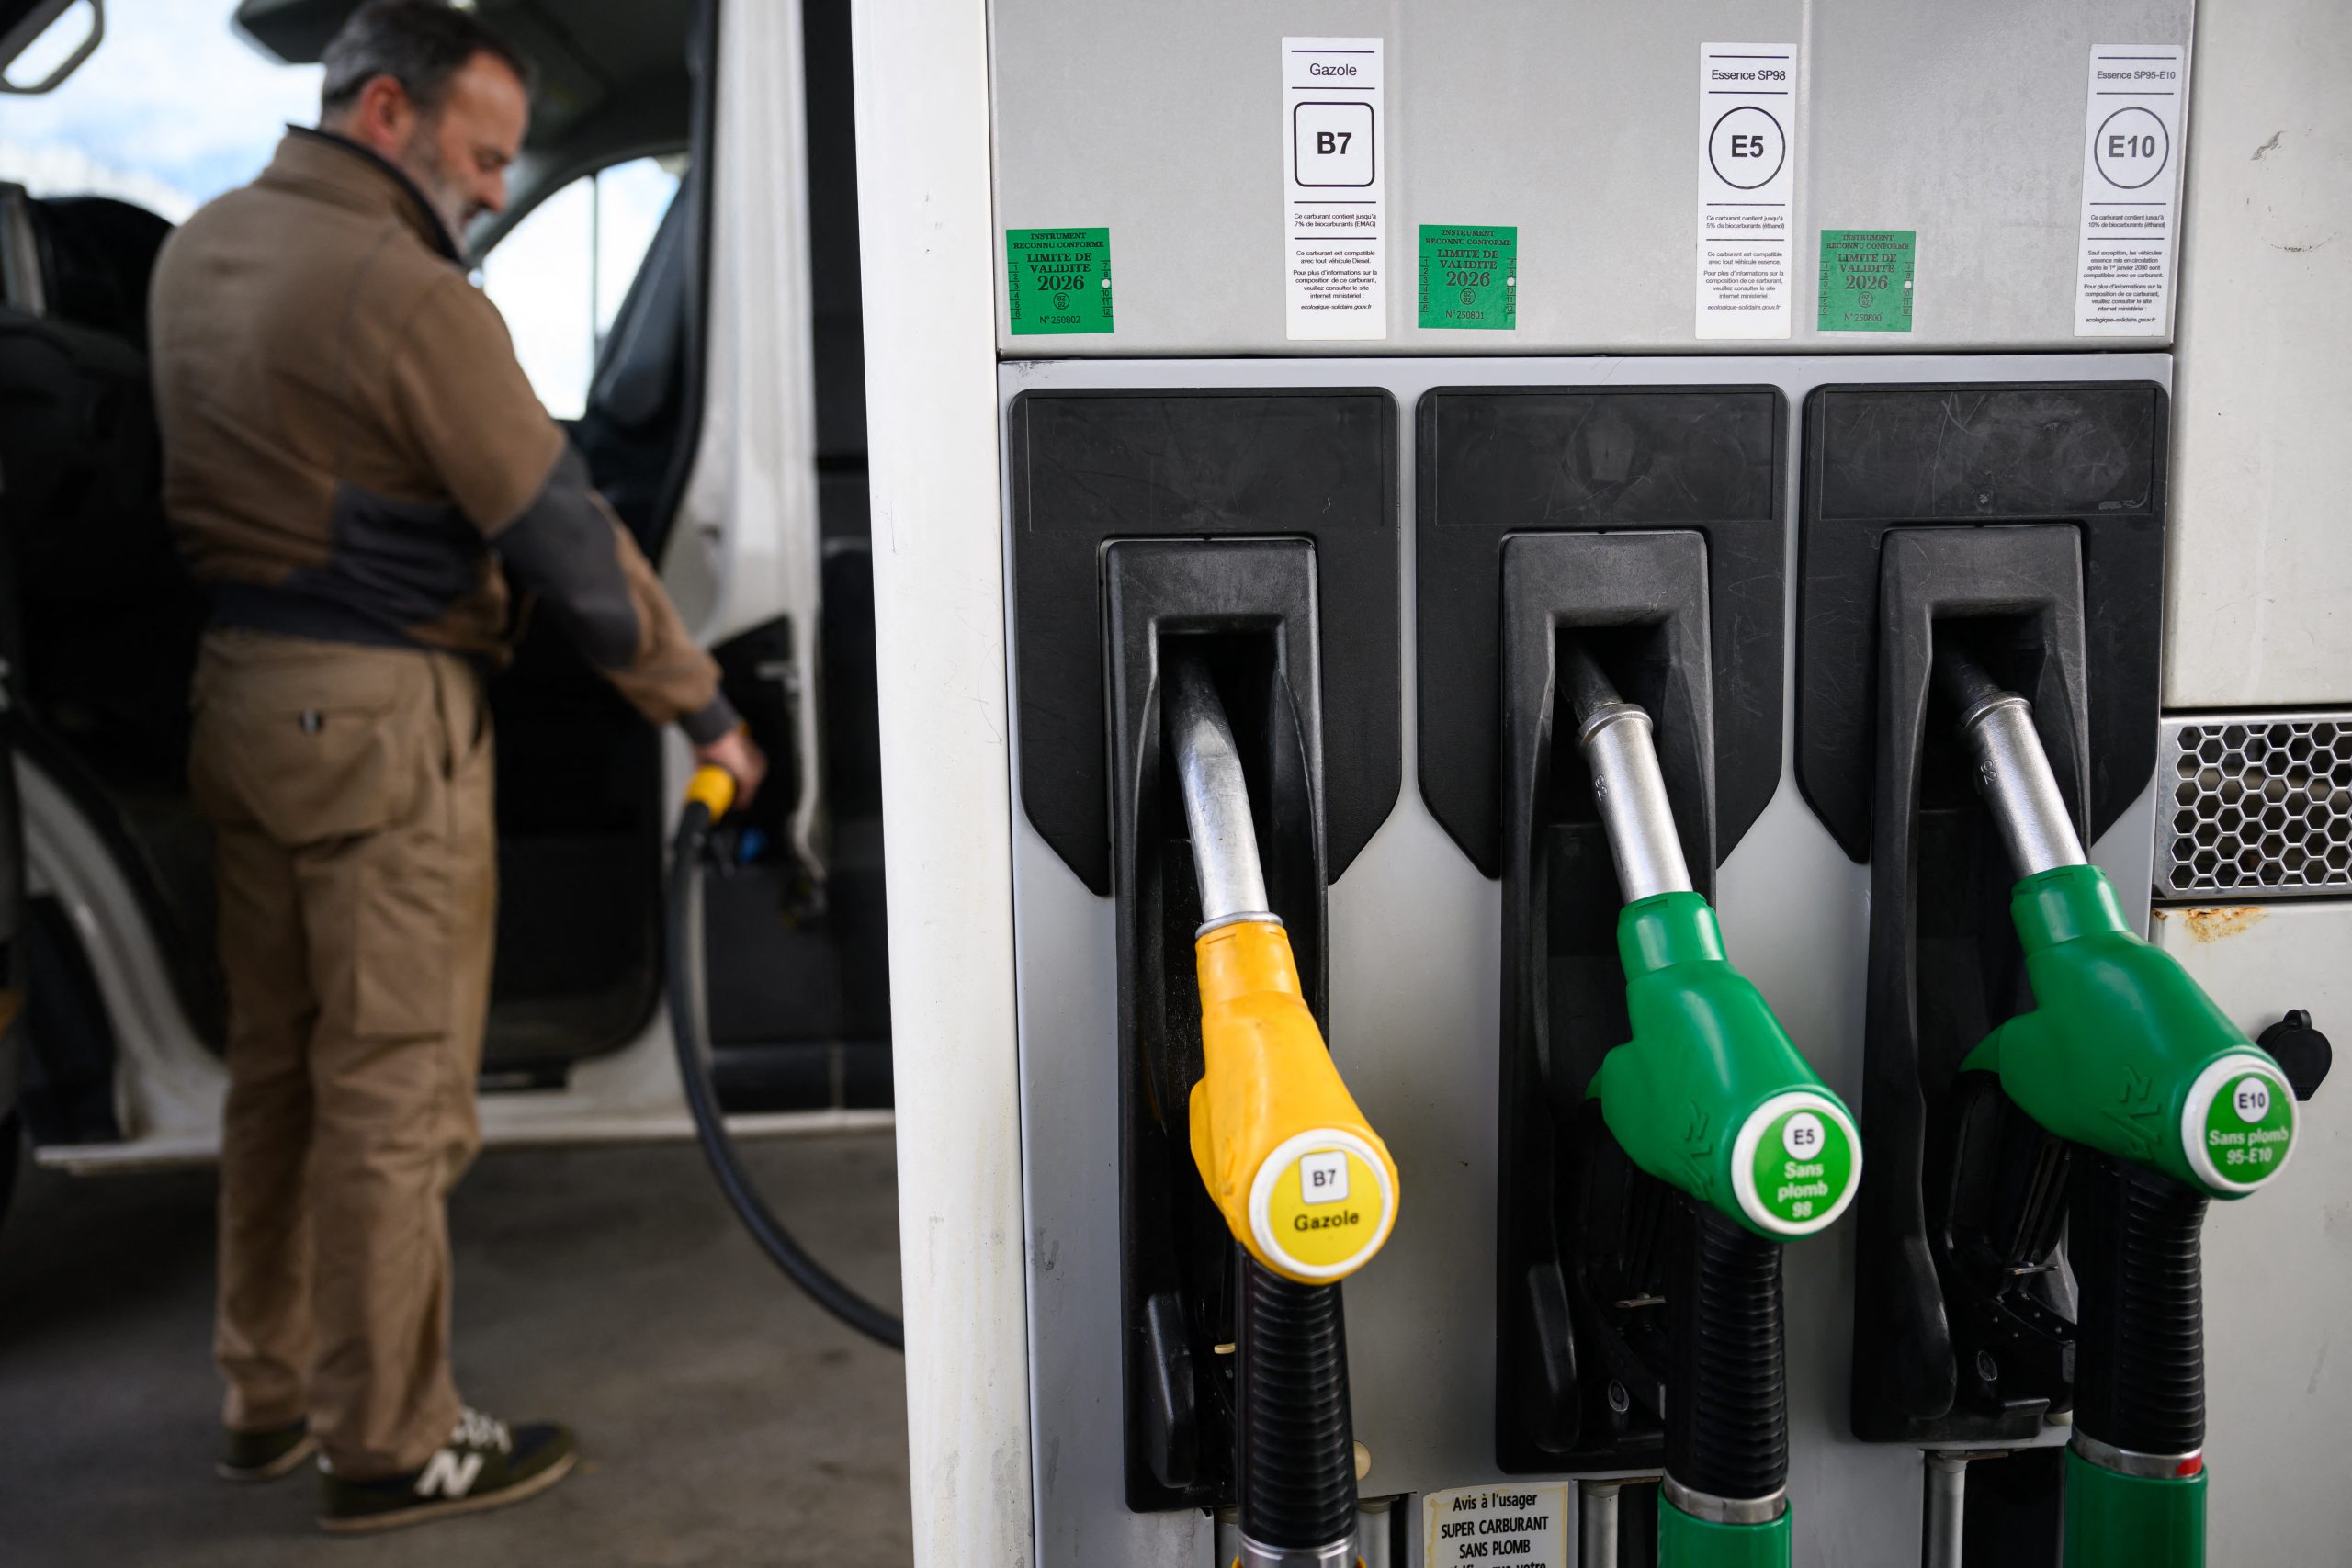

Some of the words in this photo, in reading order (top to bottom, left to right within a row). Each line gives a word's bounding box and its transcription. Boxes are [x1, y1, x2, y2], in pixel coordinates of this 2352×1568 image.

[1309, 62, 1357, 76] Gazole
[1712, 70, 1756, 80] Essence
[1758, 70, 1786, 81] SP98
[2097, 70, 2132, 80] Essence
[2134, 71, 2176, 80] SP95-E10
[1317, 131, 1352, 155] B7
[1731, 135, 1764, 158] E5
[2109, 135, 2155, 158] E10
[1027, 253, 1071, 263] LIMITE
[1075, 253, 1092, 262] DE
[1437, 249, 1480, 258] LIMITE
[1483, 250, 1499, 258] DE
[1838, 254, 1878, 262] LIMITE
[1029, 264, 1091, 273] VALIDITE
[1440, 260, 1498, 269] VALIDITE
[1839, 265, 1895, 273] VALIDITE
[1037, 275, 1085, 291] 2026
[1446, 271, 1490, 287] 2026
[1845, 275, 1888, 290] 2026
[1051, 316, 1081, 324] 250802
[1456, 311, 1485, 320] 250801
[2238, 1093, 2266, 1109] E10
[1793, 1129, 1815, 1145] E5
[2209, 1129, 2245, 1145] Sans
[2247, 1125, 2289, 1146] plomb
[2226, 1148, 2273, 1165] 95-E10
[1312, 1169, 1337, 1187] B7
[1784, 1161, 1824, 1179] Sans
[1778, 1181, 1828, 1203] plomb
[1792, 1201, 1813, 1219] 98
[1294, 1211, 1360, 1231] Gazole
[414, 1449, 484, 1498] N
[1453, 1496, 1476, 1512] Avis
[1481, 1494, 1487, 1508] à
[1492, 1492, 1537, 1510] l'usager
[1441, 1521, 1475, 1539] SUPER
[1479, 1516, 1549, 1535] CARBURANT
[1459, 1542, 1488, 1559] SANS
[1492, 1539, 1531, 1555] PLOMB
